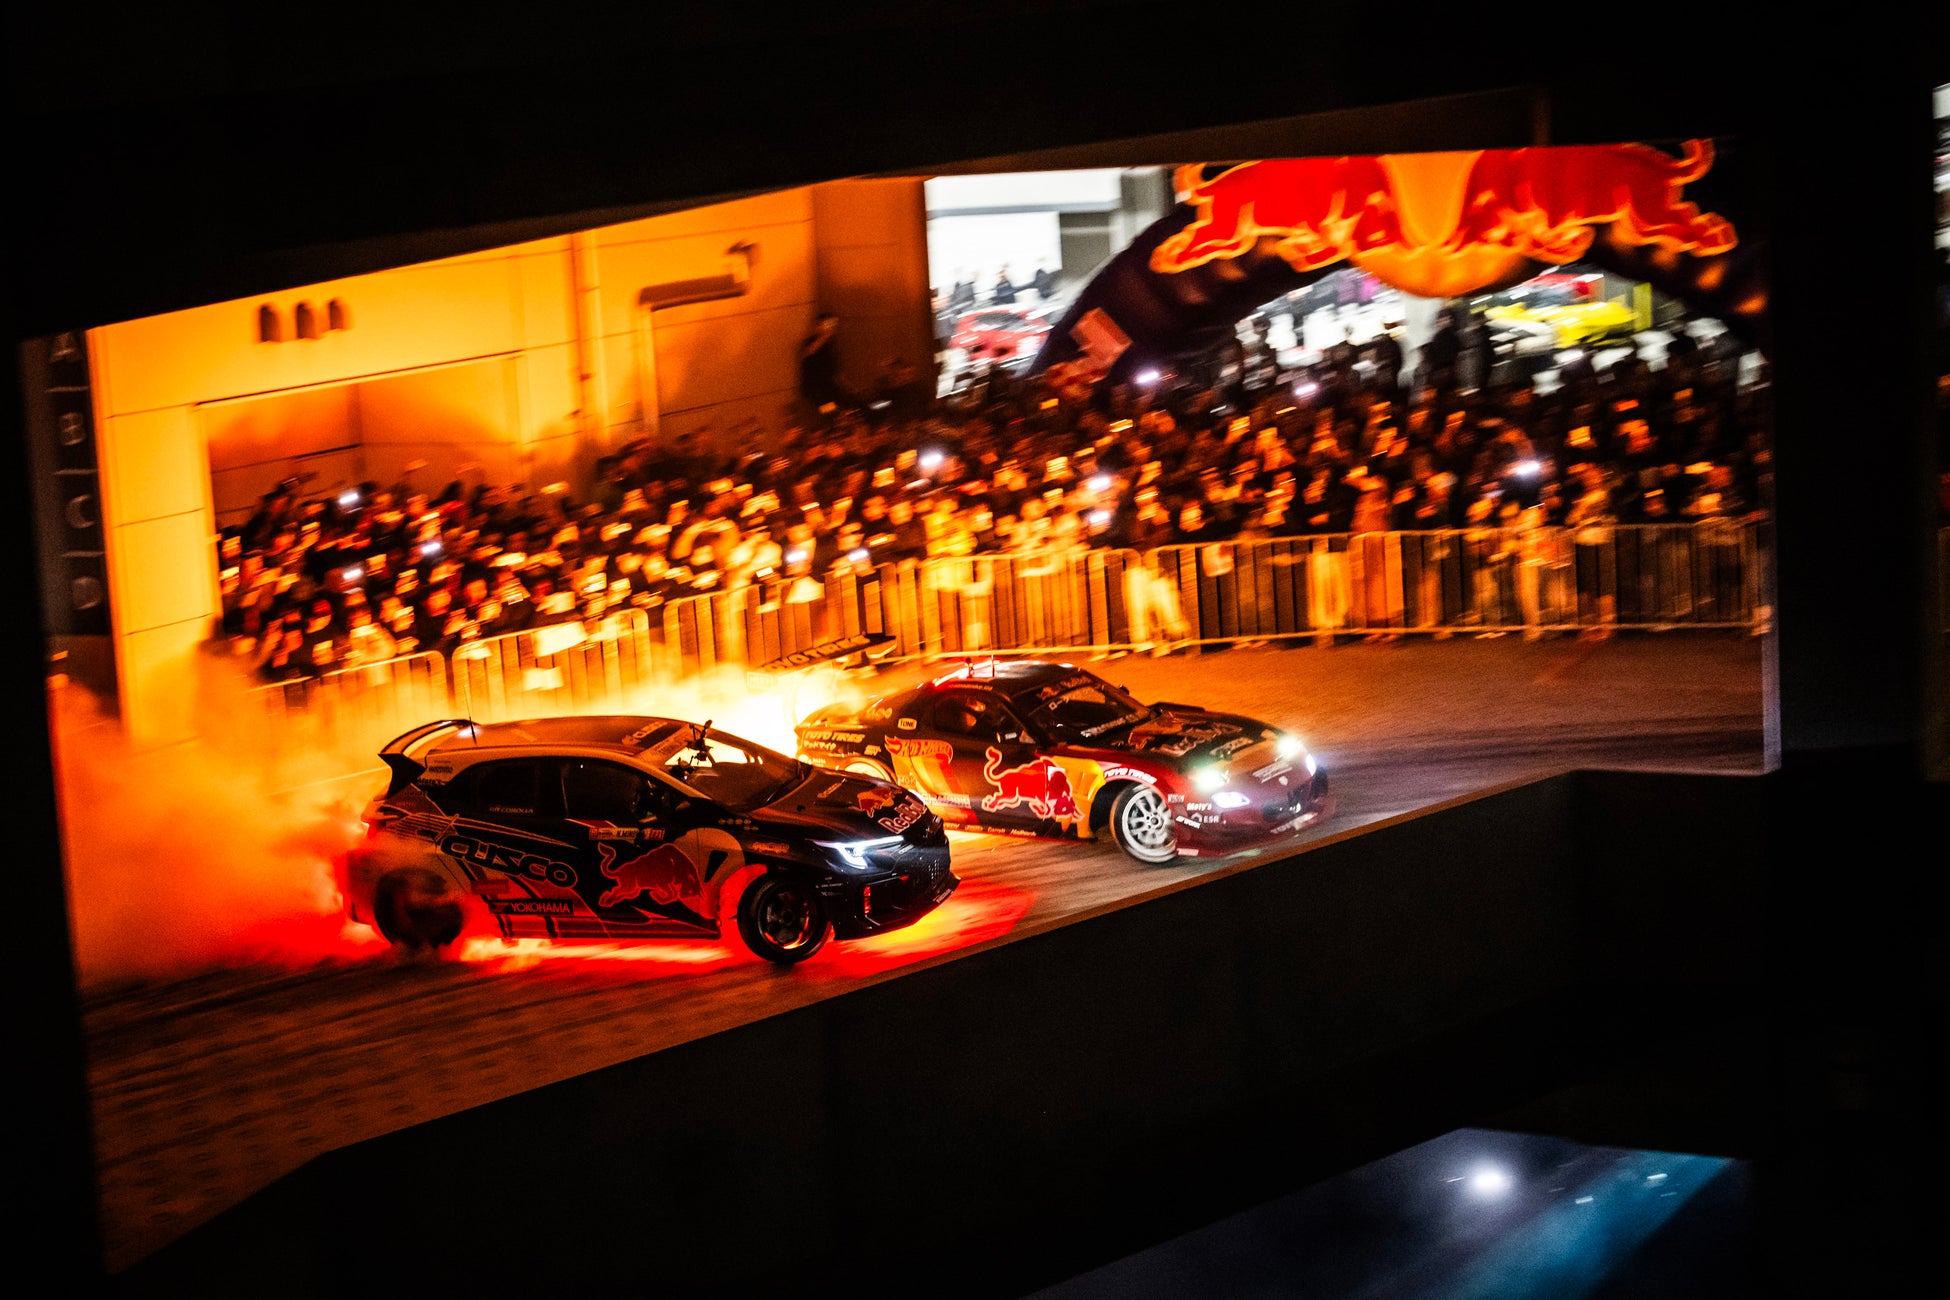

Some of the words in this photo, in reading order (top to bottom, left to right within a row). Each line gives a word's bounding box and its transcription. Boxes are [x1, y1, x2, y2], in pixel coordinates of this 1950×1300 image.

[58, 410, 87, 446] B
[65, 493, 95, 528] C
[439, 834, 579, 890] CUSCO
[511, 902, 571, 913] YOKOHAMA
